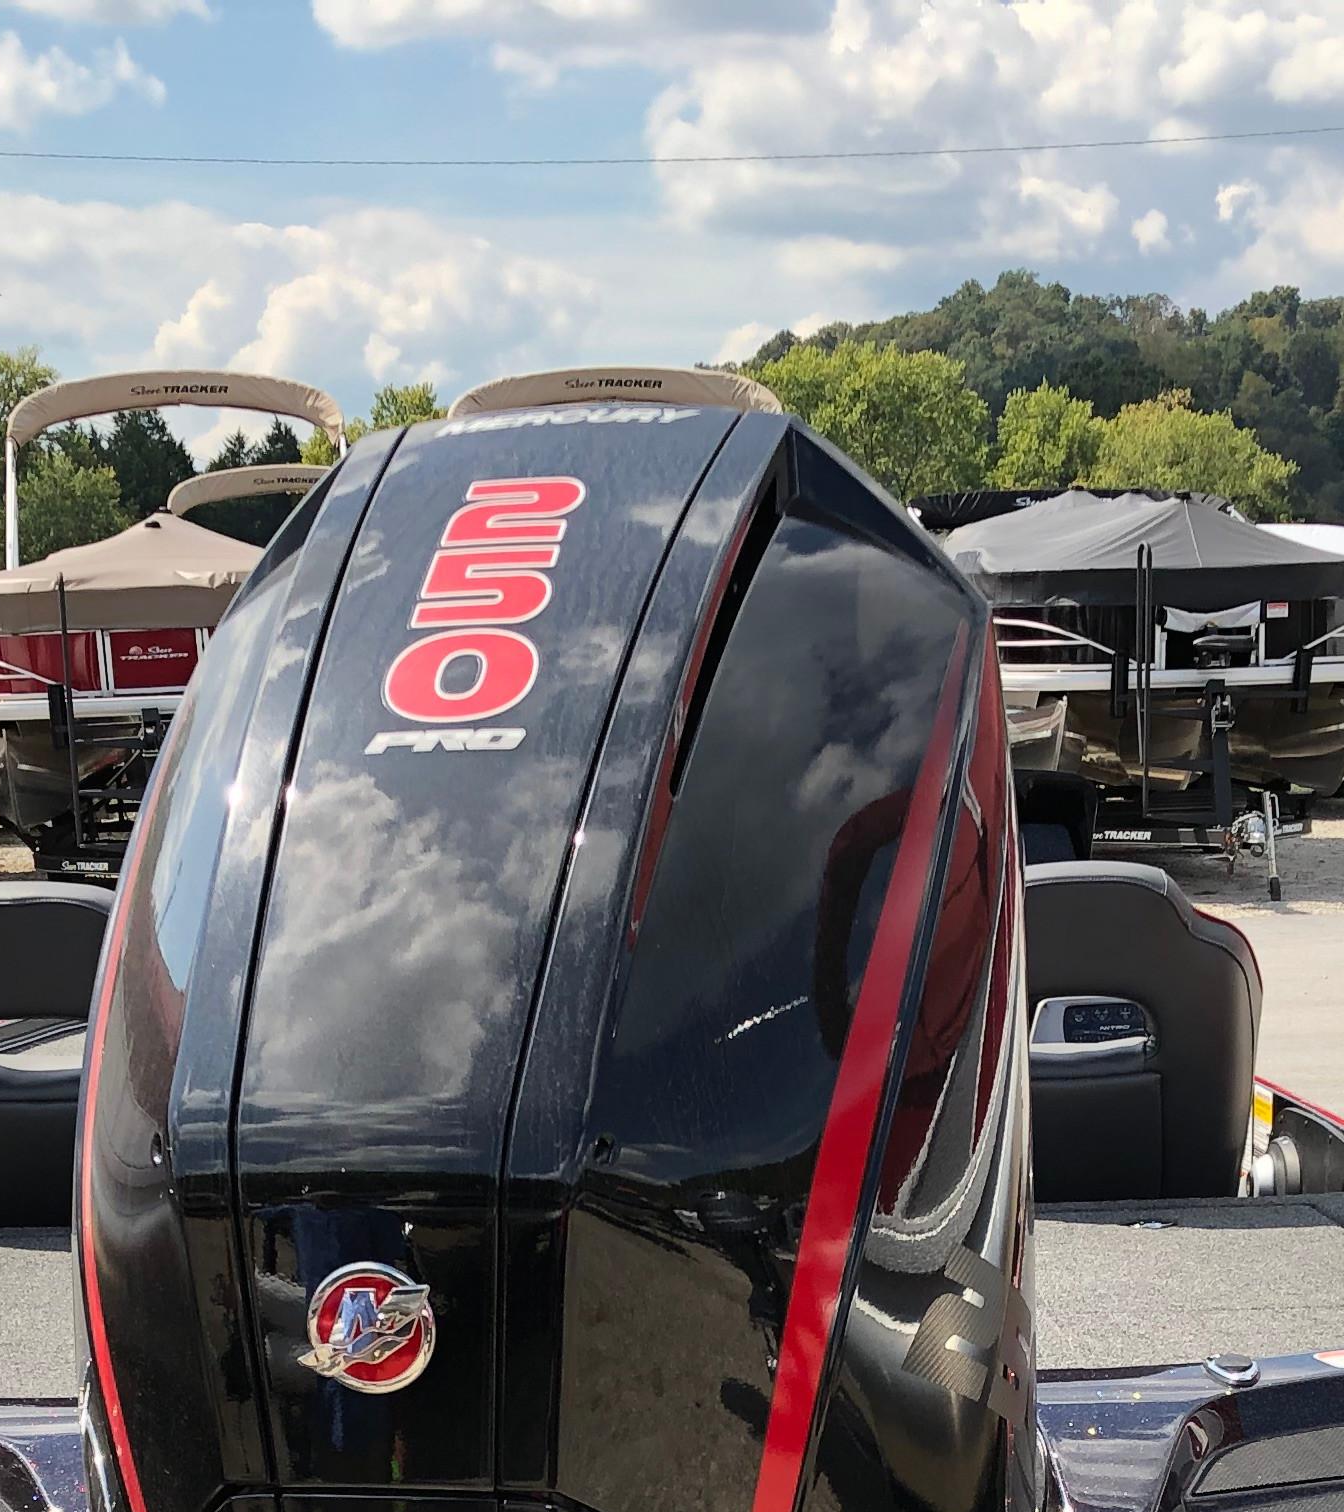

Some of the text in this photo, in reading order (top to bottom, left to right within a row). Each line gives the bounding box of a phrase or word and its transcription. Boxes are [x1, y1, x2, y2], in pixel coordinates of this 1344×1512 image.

[162, 385, 229, 394] TRACKER
[596, 379, 663, 389] TRACKER
[435, 407, 702, 438] MERCURY
[381, 475, 587, 724] 250
[364, 727, 527, 755] PRO
[1104, 830, 1152, 841] TRACKER
[76, 861, 109, 871] TRACKER
